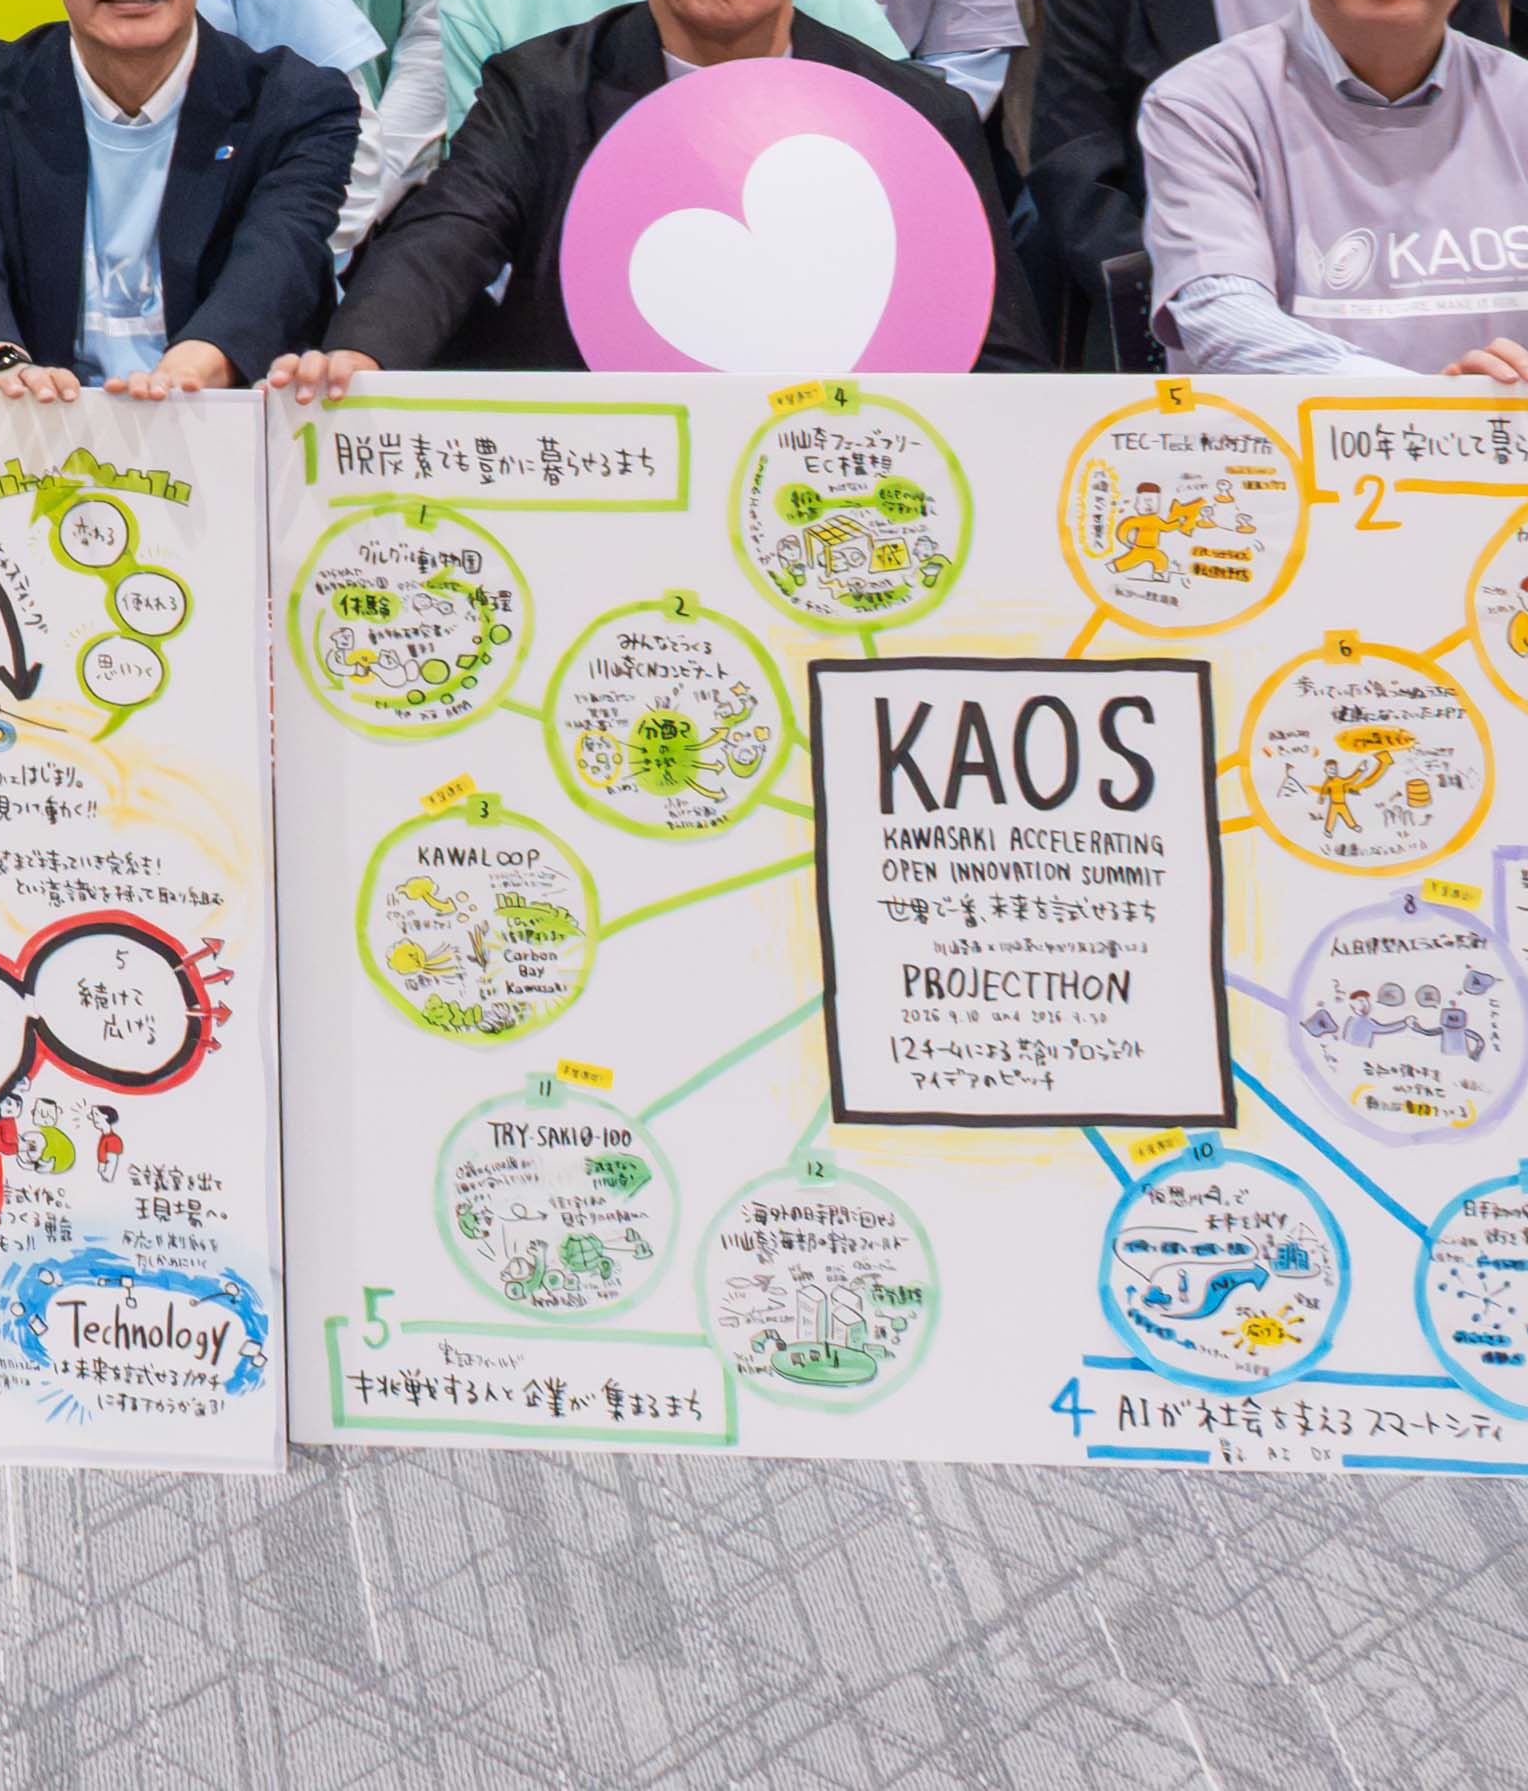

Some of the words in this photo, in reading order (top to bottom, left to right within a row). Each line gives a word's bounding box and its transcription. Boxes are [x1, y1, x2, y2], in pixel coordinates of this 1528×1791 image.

[833, 387, 849, 408] 4
[292, 421, 318, 485] 1
[333, 432, 657, 487] 脱炭素でも豊かに暮らせるまち
[1353, 473, 1404, 531] 2
[673, 596, 690, 618] 2
[873, 693, 1156, 816] KAOS
[882, 825, 996, 854] KAWASAKI
[1009, 826, 1165, 858] ACCELERATING
[881, 859, 938, 884] OPEN
[950, 860, 1072, 883] INNOVATION
[1081, 864, 1167, 888] SUMMIT
[115, 948, 127, 971] 5
[78, 982, 145, 1010] 続けて
[901, 963, 1132, 1006] PROJECTTHON
[103, 1014, 157, 1045] 広げる
[1192, 1141, 1214, 1162] 10
[806, 1160, 826, 1179] 12
[56, 1301, 231, 1360] Technology
[362, 1284, 395, 1351] 5
[1048, 1375, 1096, 1439] 4
